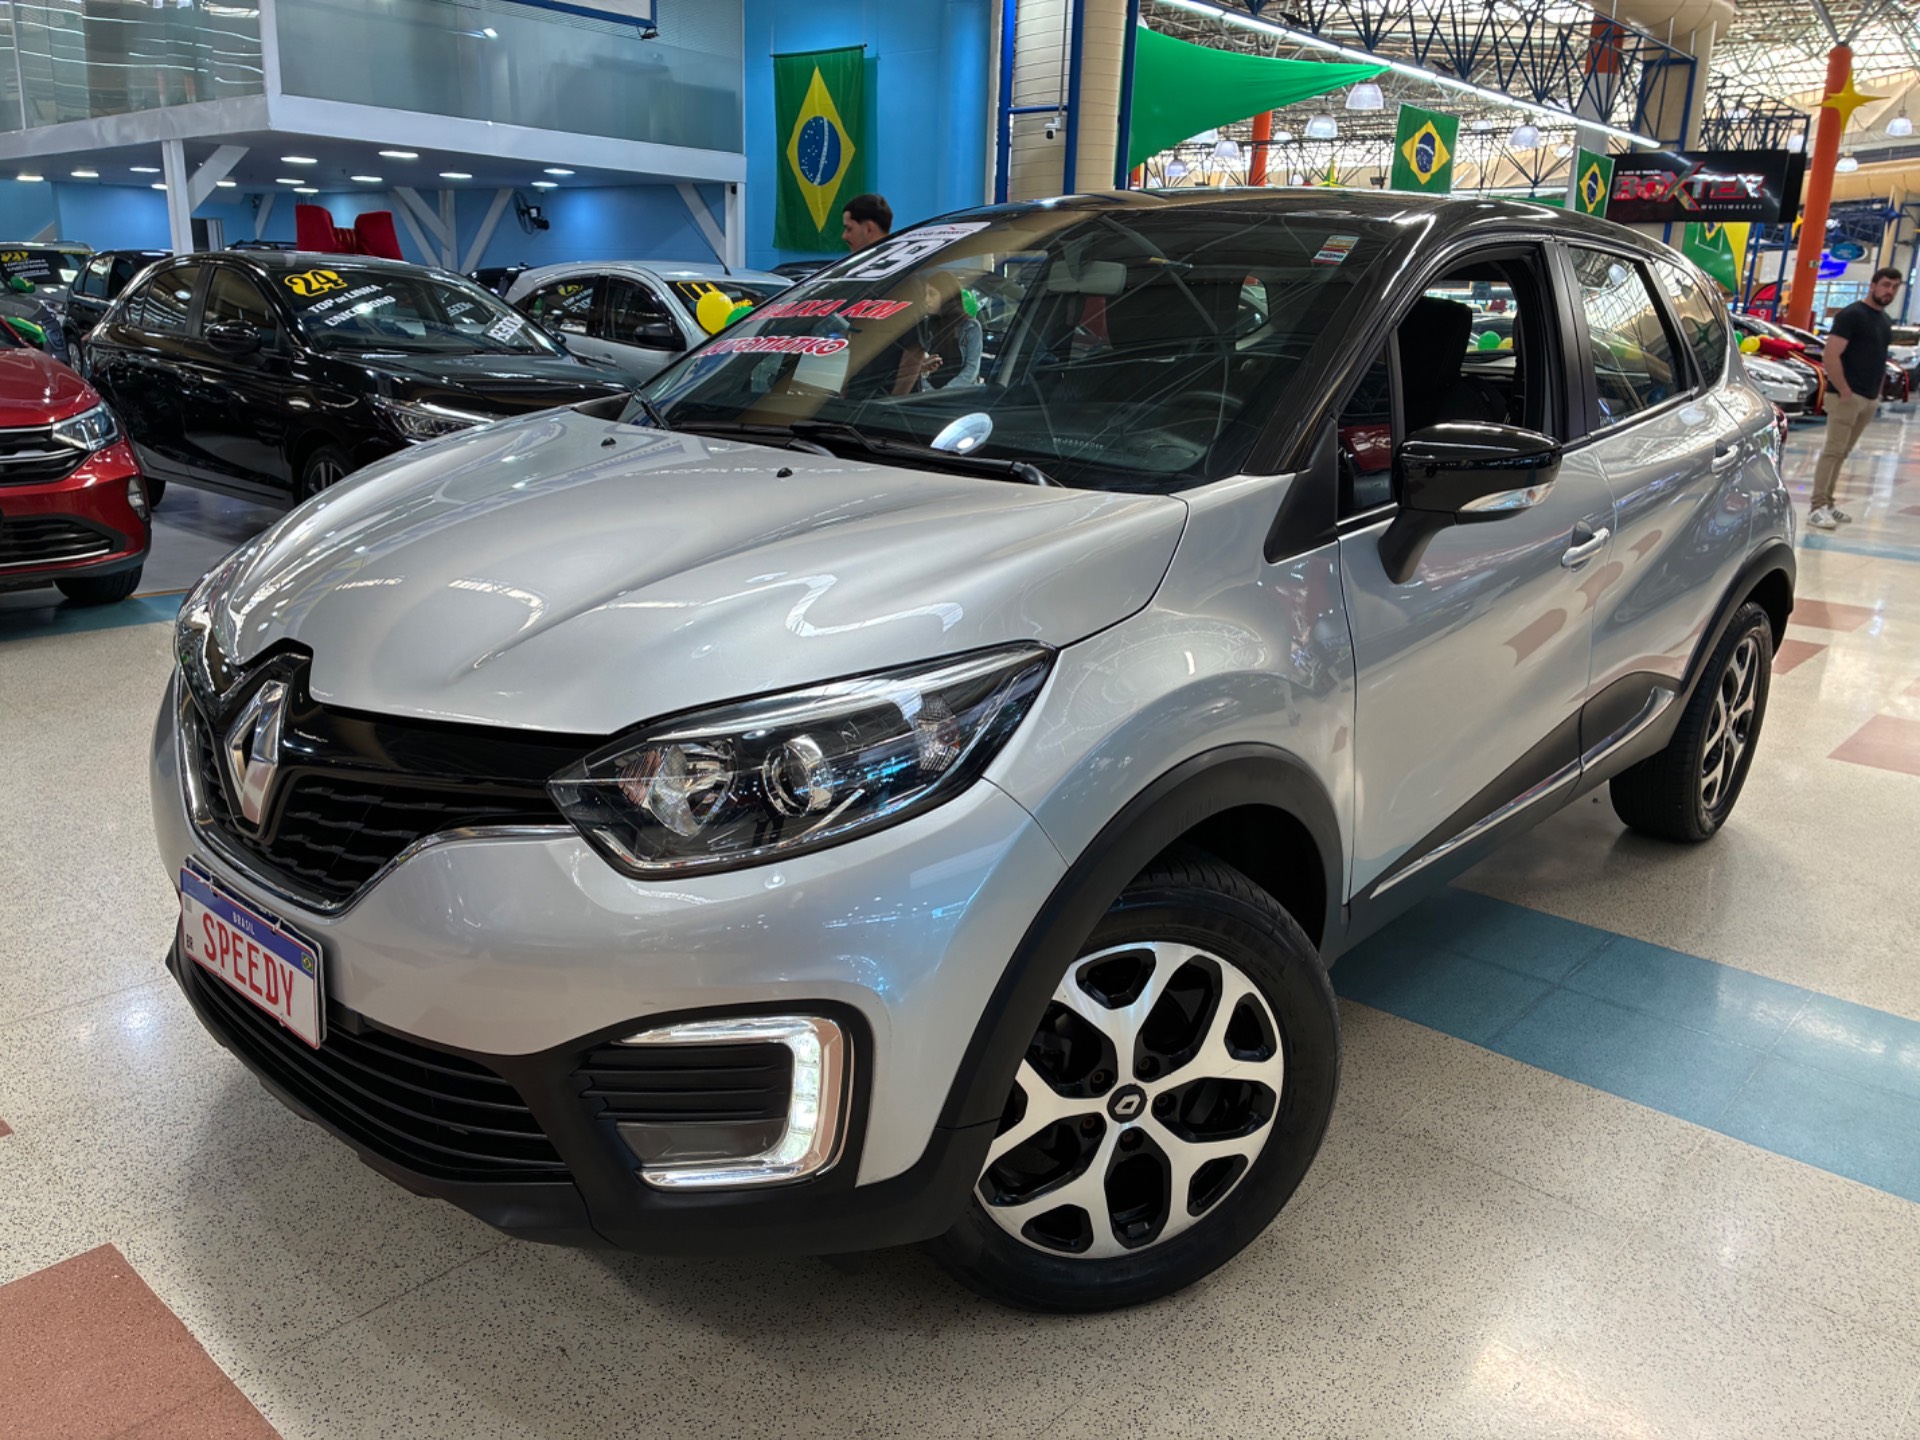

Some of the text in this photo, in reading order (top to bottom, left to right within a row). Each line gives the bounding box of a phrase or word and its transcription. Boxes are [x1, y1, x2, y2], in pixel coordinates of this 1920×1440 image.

[1612, 162, 1765, 211] BOXTER
[1700, 203, 1763, 211] MULTIMARCAS
[285, 269, 347, 297] 24
[307, 298, 334, 314] TOP
[839, 299, 913, 320] KM
[232, 911, 255, 935] BRASIL
[203, 912, 294, 1017] SPEEDY
